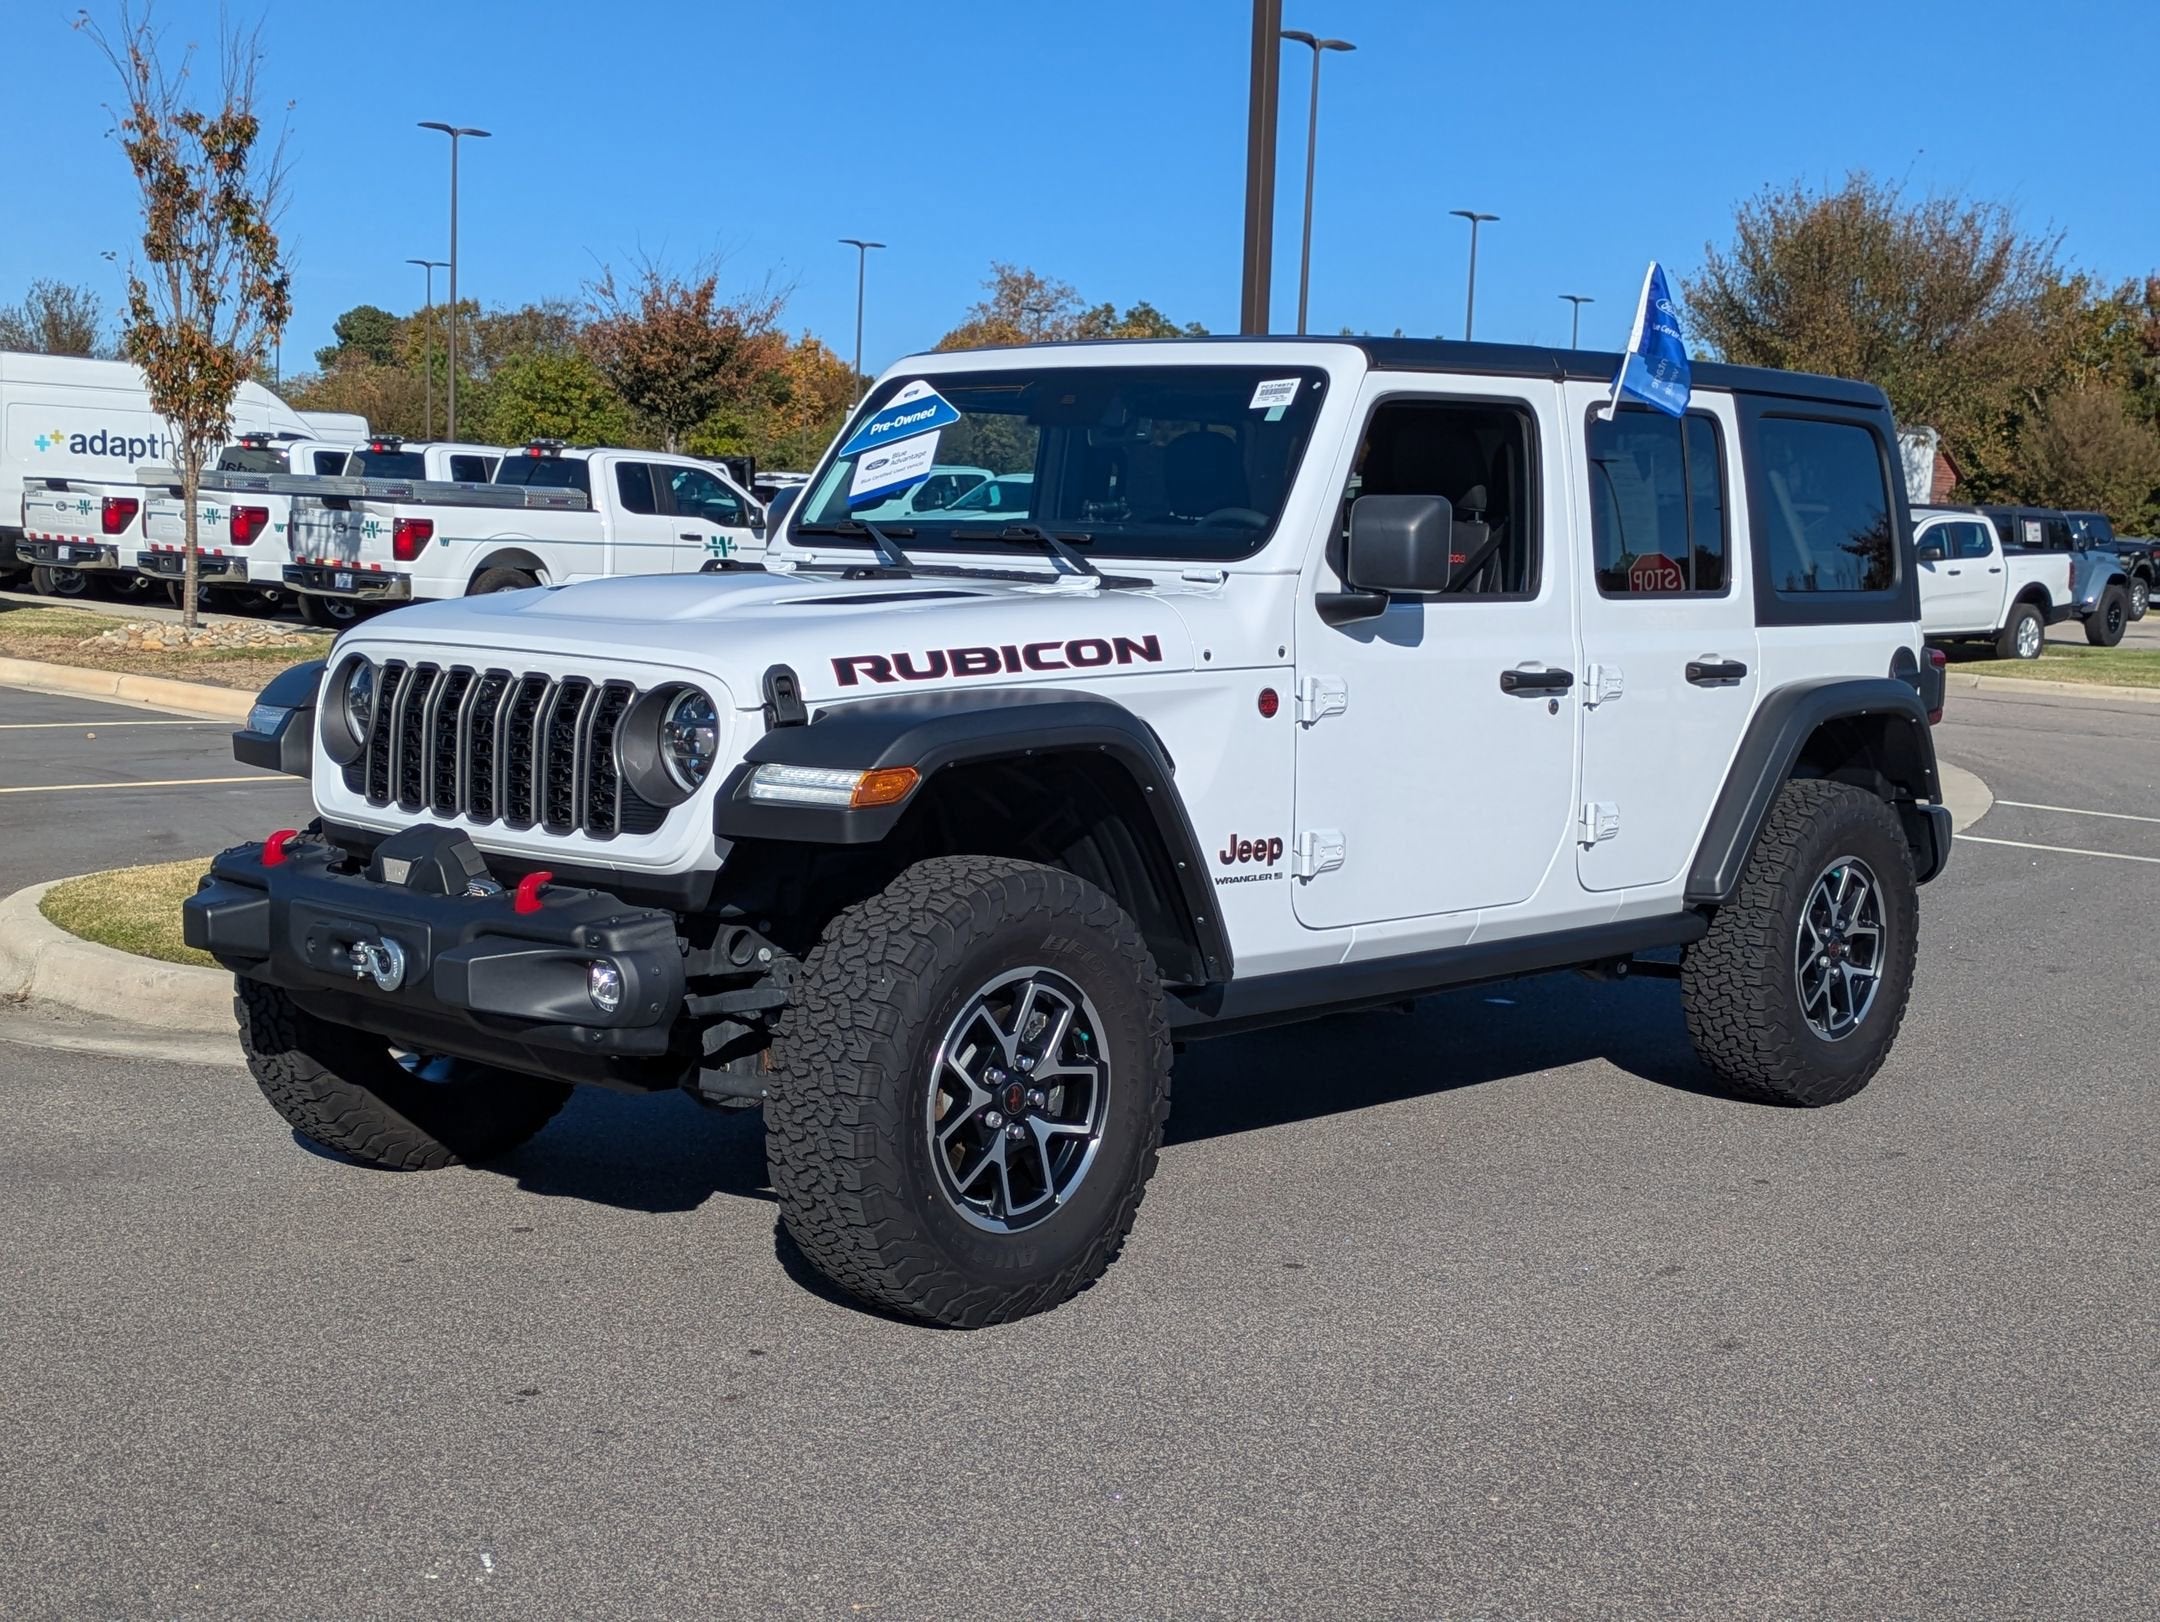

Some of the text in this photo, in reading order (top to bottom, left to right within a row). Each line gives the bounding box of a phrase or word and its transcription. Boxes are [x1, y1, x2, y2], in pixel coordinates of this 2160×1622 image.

[870, 405, 937, 435] Pre-Owned
[830, 634, 1163, 687] RUBICON
[1219, 833, 1284, 867] Jeep
[1214, 873, 1273, 886] WRANGLER
